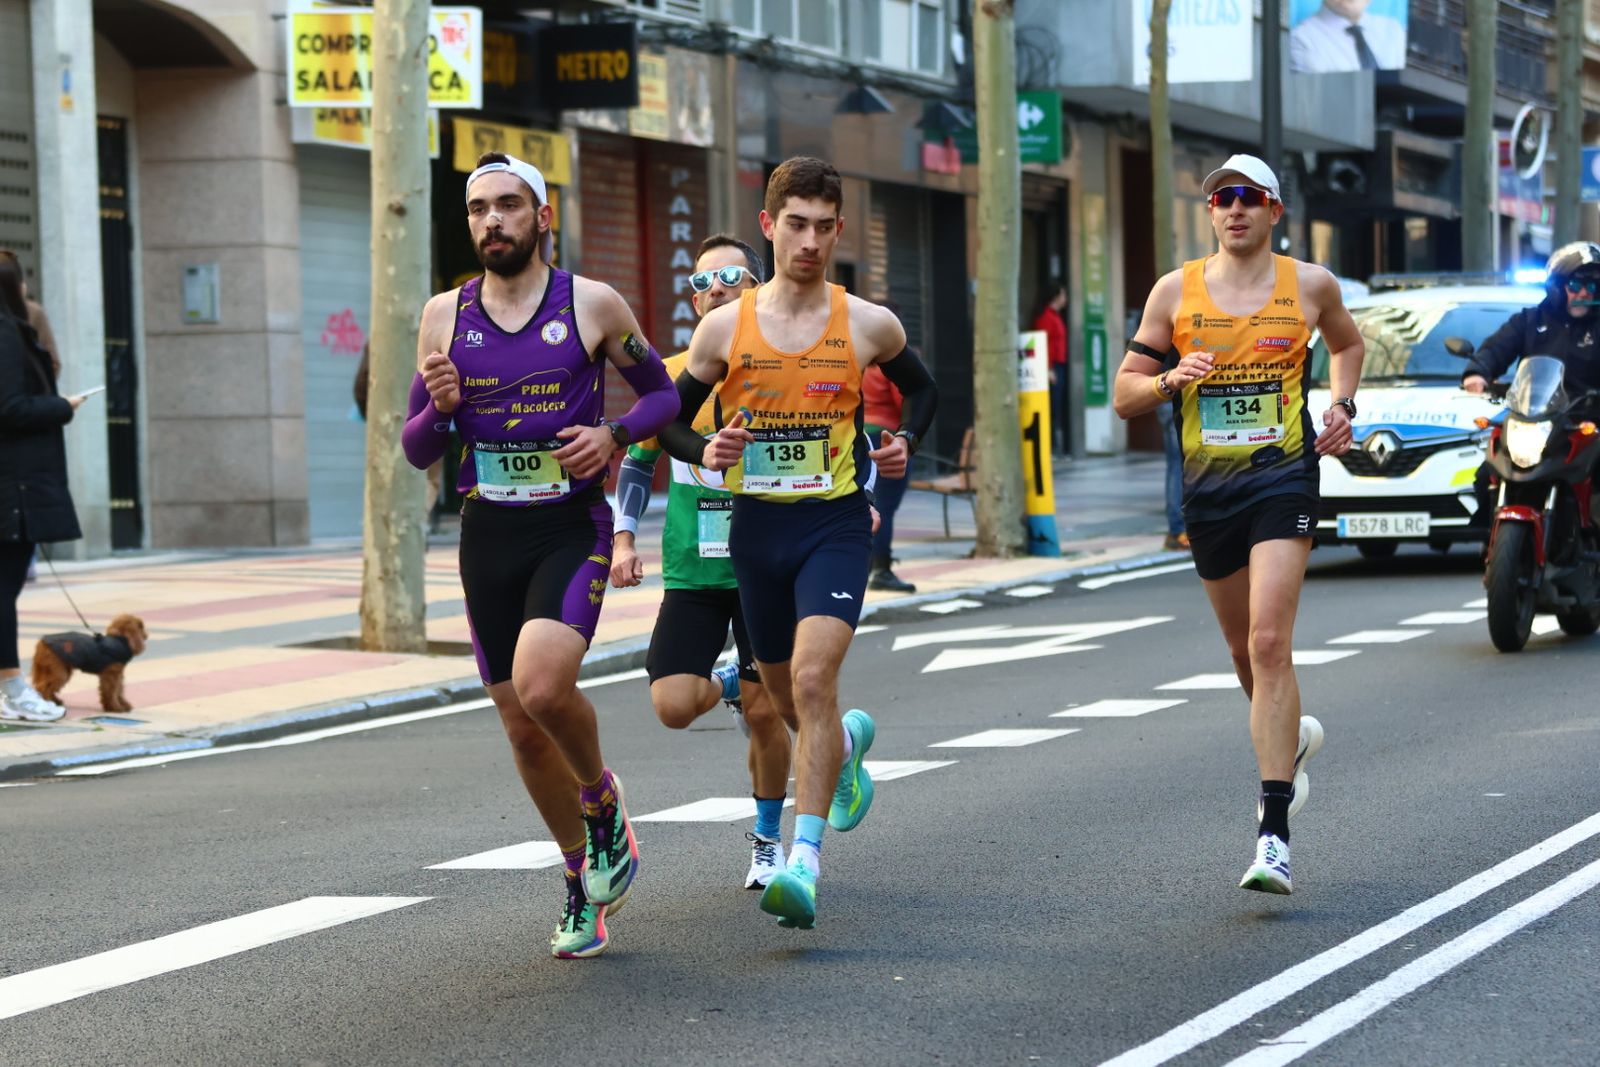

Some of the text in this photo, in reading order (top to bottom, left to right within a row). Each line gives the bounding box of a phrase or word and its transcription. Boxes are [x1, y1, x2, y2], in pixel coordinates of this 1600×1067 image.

[297, 33, 371, 53] COMPR
[557, 49, 630, 82] METRO
[669, 168, 695, 348] PARAFAR
[464, 376, 499, 387] Jamón
[521, 382, 561, 395] PRIM
[511, 401, 566, 413] Macotera
[753, 410, 845, 419] ESCUELA TRIATLÓN
[1221, 398, 1262, 416] 134
[765, 444, 806, 462] 138
[1024, 411, 1043, 496] 1
[498, 455, 541, 472] 100
[1349, 517, 1426, 534] 5578 LRC
